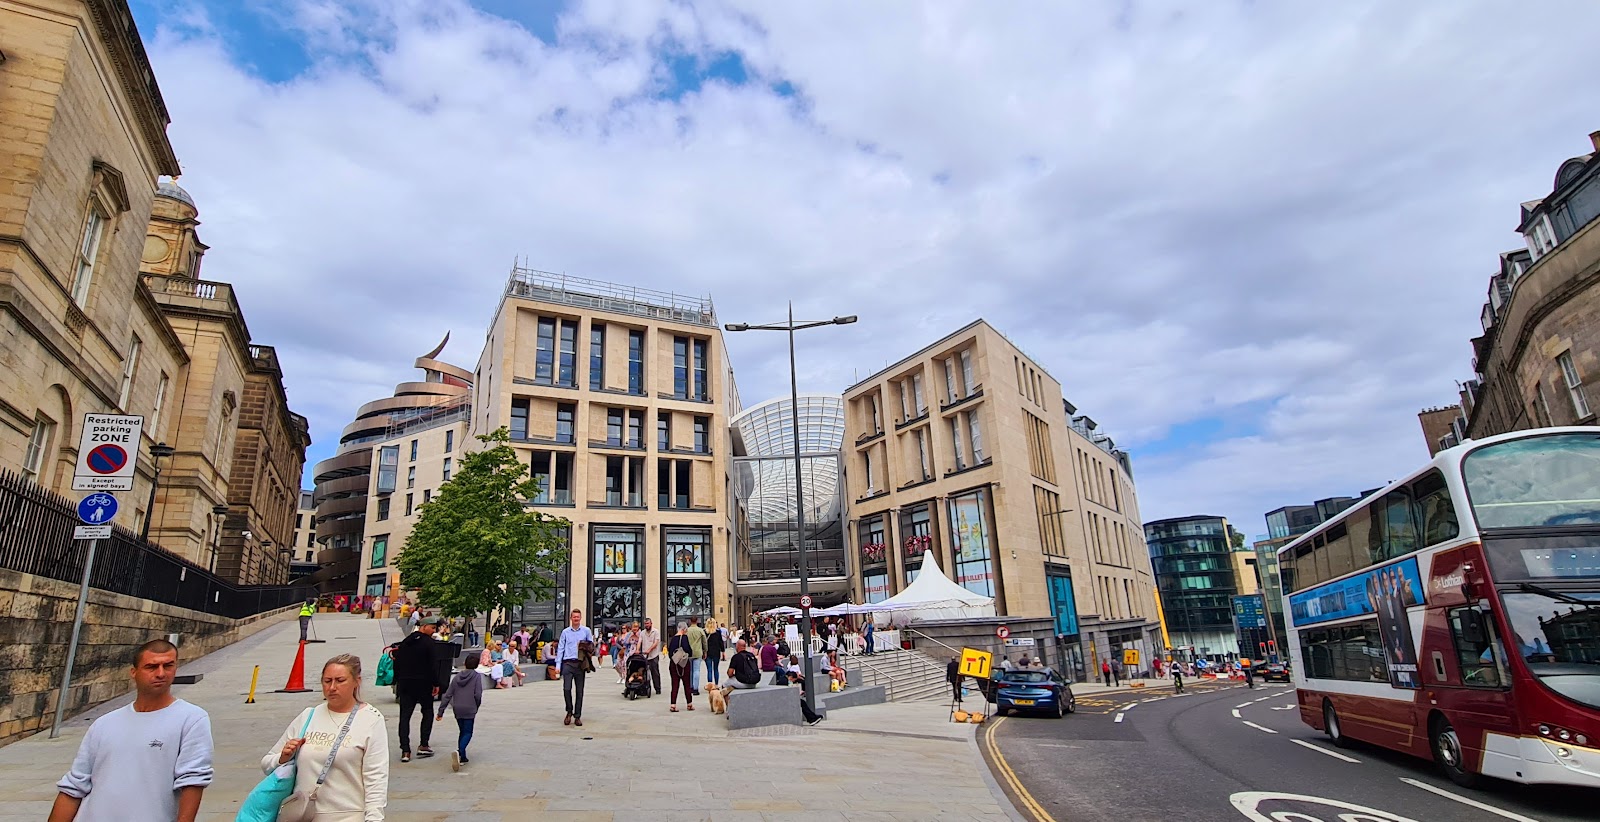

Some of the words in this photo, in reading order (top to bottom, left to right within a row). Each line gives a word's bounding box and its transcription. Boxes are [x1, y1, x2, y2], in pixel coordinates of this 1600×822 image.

[87, 416, 140, 425] Restricted
[93, 426, 131, 434] parking
[91, 433, 130, 443] ZONE
[1441, 574, 1463, 589] Lothian
